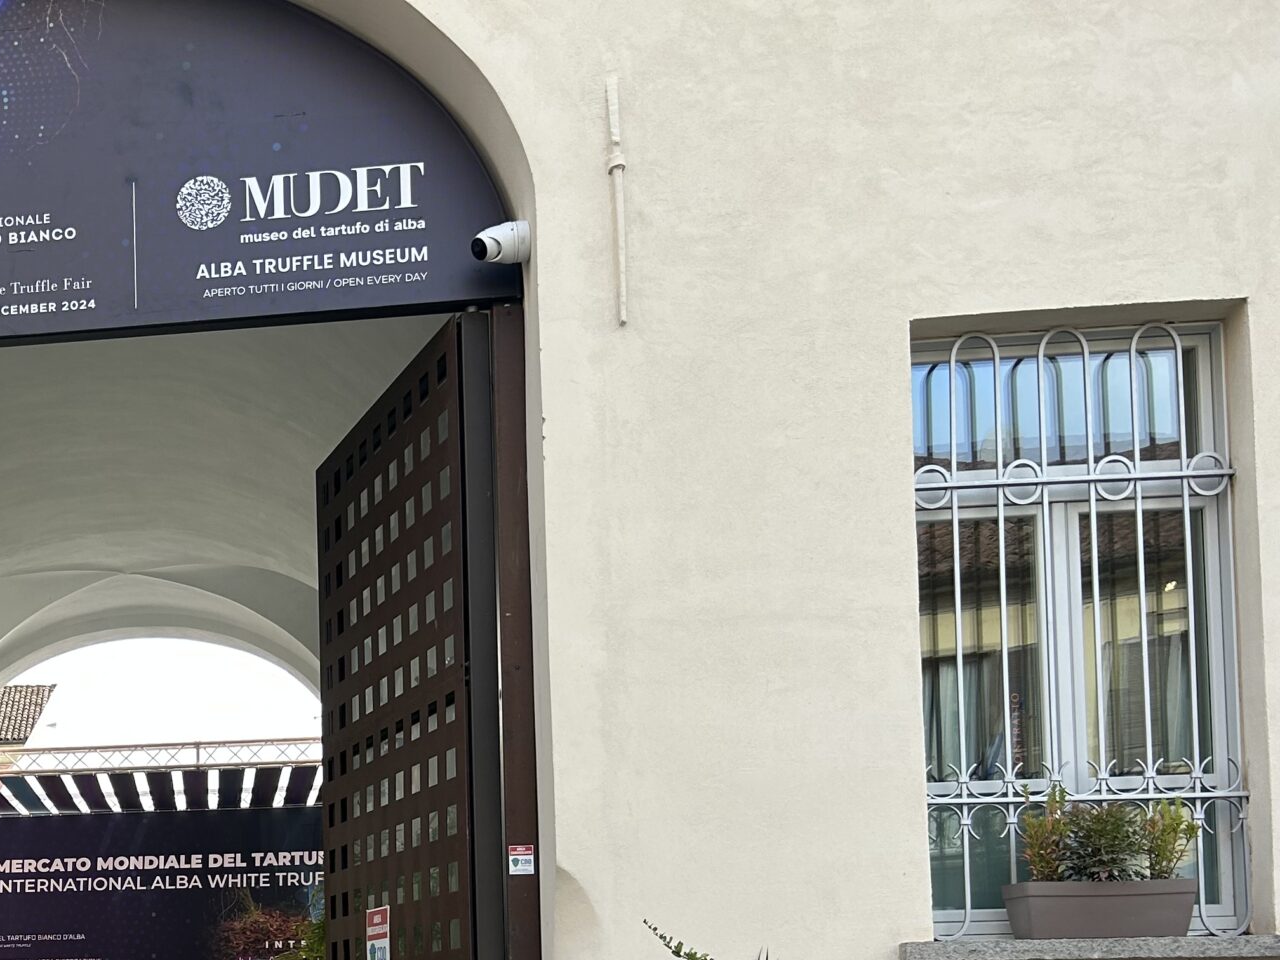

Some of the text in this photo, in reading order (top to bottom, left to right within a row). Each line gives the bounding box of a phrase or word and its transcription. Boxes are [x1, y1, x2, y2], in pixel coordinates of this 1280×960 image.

[240, 162, 425, 222] MUDET
[8, 227, 77, 245] BIANCO
[240, 218, 426, 244] museo del tartufo di alba
[196, 246, 428, 280] ALBA TRUFFLE MUSEUM
[10, 279, 58, 295] Truffle
[63, 277, 92, 291] Fair
[203, 286, 246, 298] APERTO
[248, 283, 279, 295] TUTTI
[286, 280, 324, 291] GIORNI
[333, 276, 364, 288] OPEN
[367, 273, 402, 285] EVERY
[405, 271, 428, 283] DAY
[62, 298, 96, 312] 2024
[96, 854, 202, 871] MONDIALE
[208, 853, 247, 868] DEL
[151, 873, 202, 890] ALBA
[207, 872, 270, 888] WHITE
